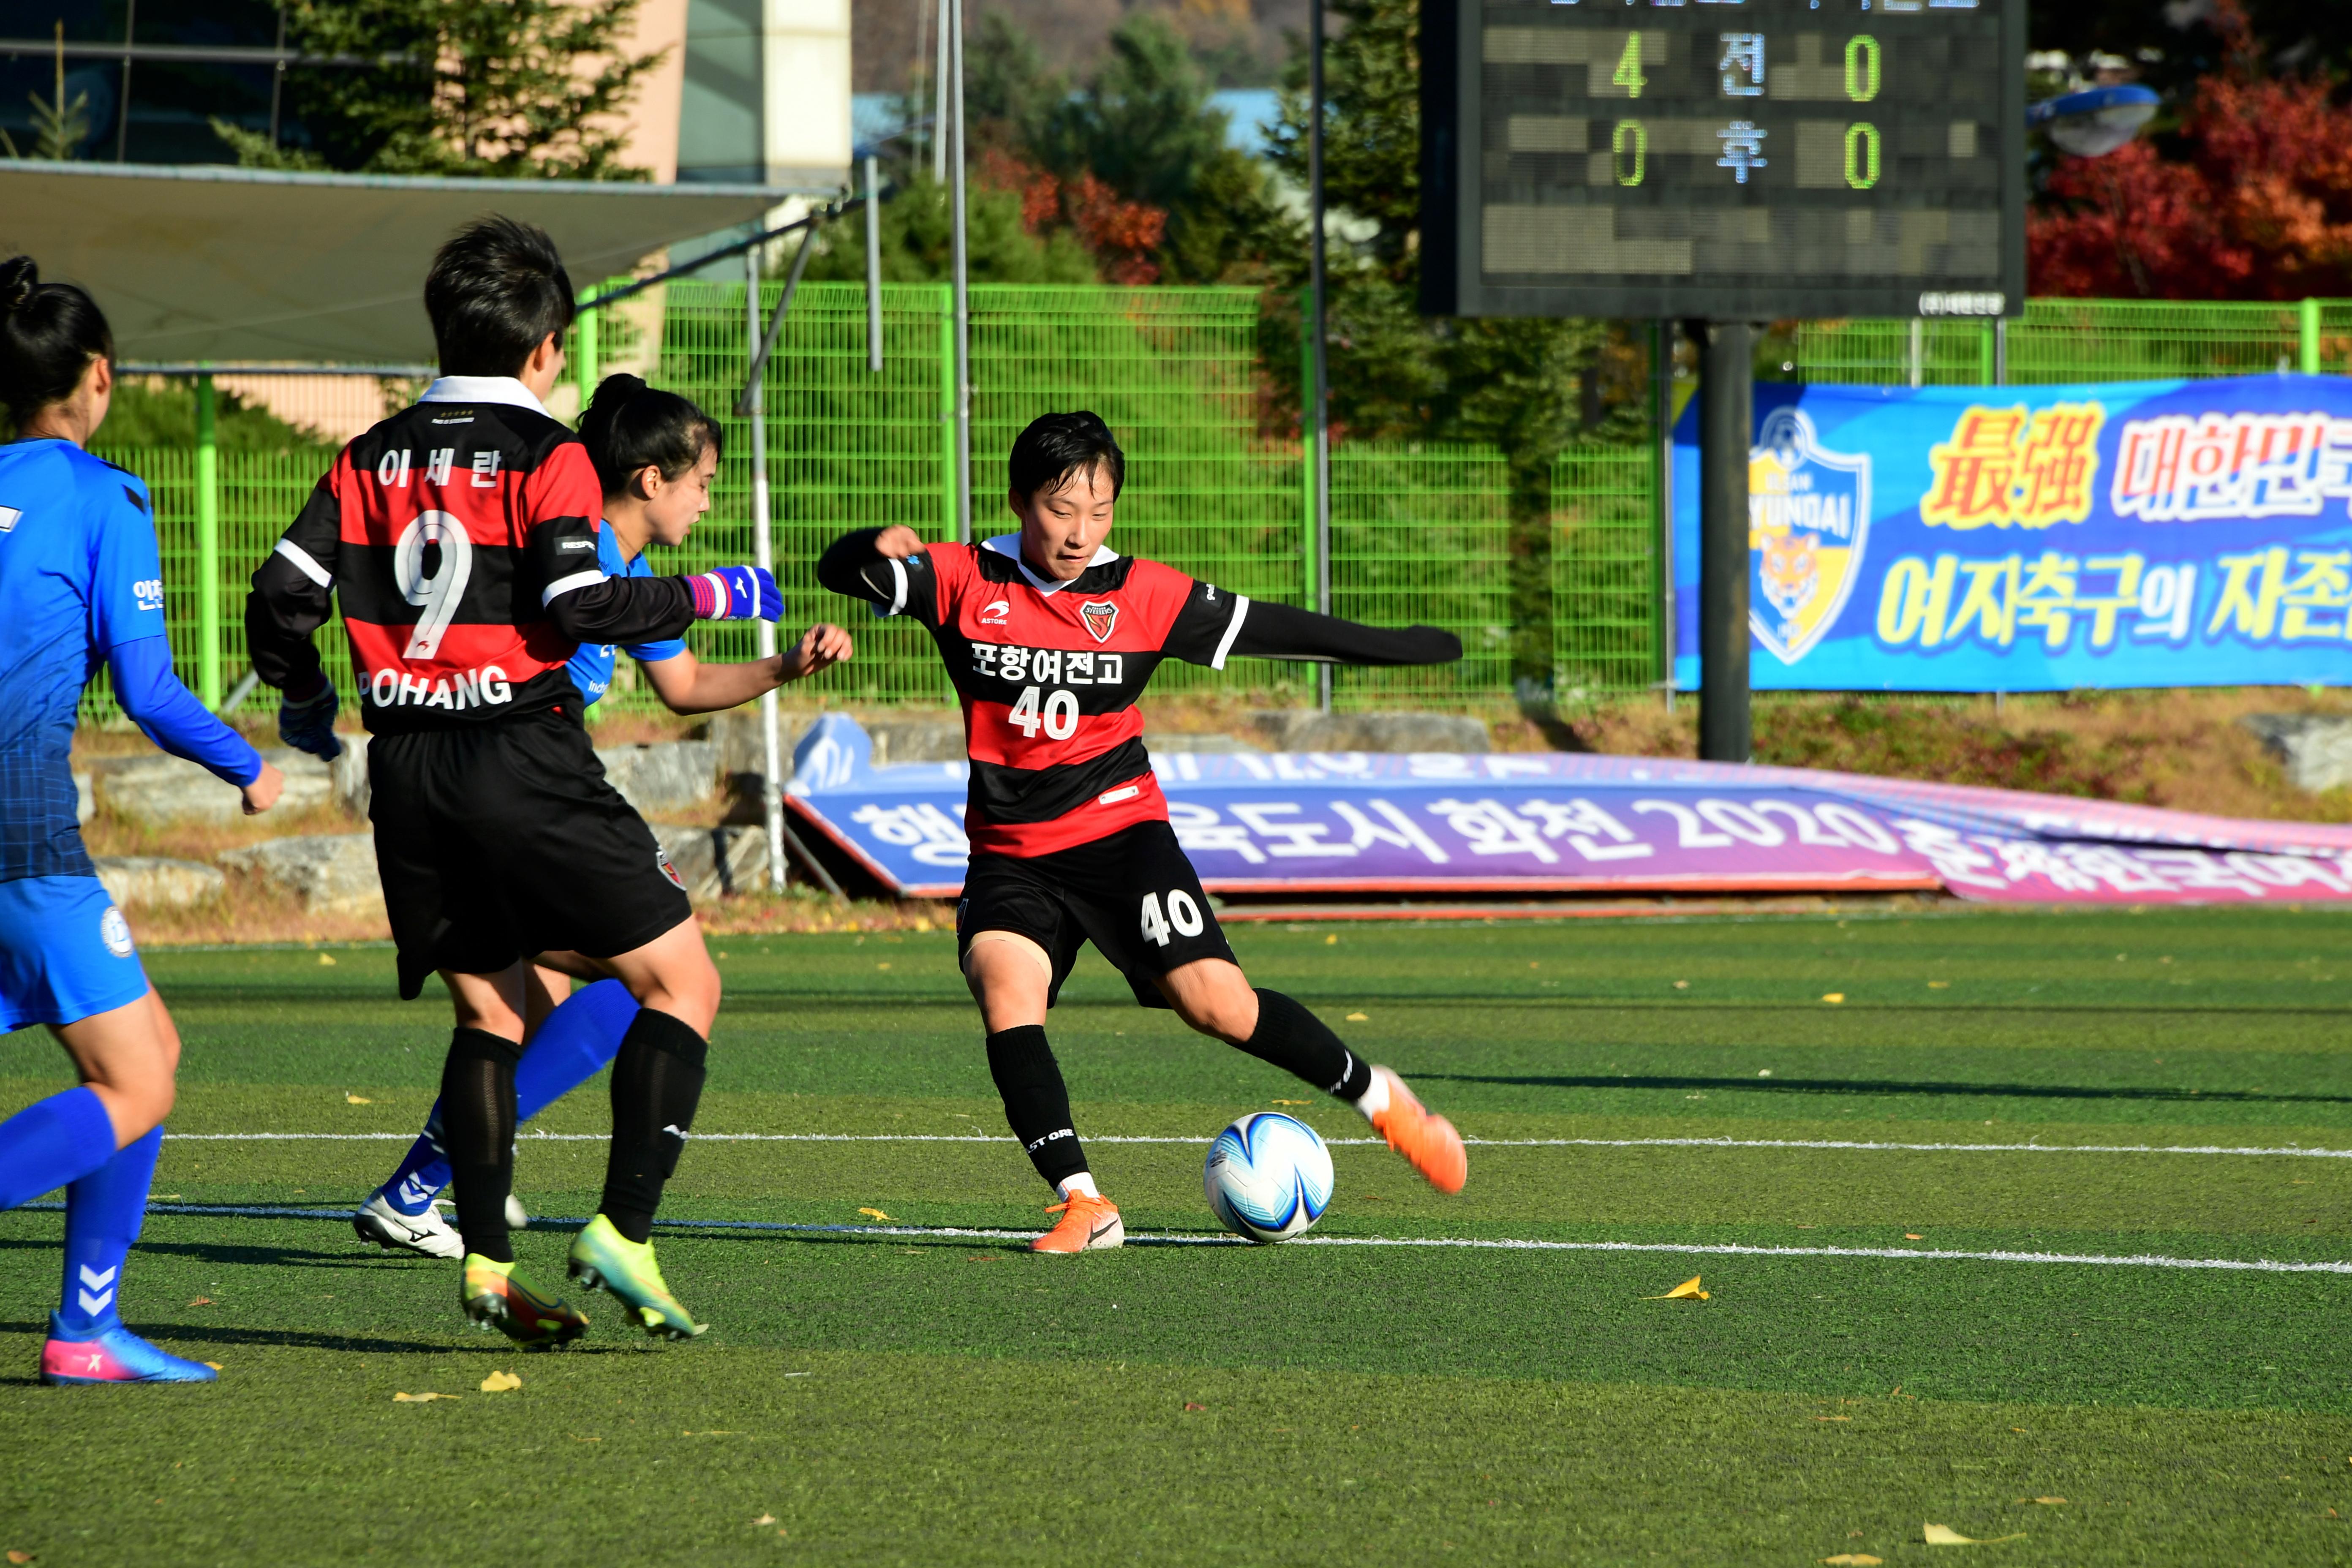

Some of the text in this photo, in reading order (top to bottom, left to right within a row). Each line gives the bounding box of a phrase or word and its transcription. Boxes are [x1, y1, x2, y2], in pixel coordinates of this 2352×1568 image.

[1613, 31, 1881, 102] 4 전 0
[1612, 119, 1881, 190] 0 후 0
[1749, 493, 1852, 540] YUNDAI
[394, 509, 473, 660] 9
[1877, 547, 2352, 647] 여자축구의 자존
[971, 642, 1123, 685] 포항여전고
[1008, 686, 1080, 740] 40
[1631, 798, 1900, 855] 2020
[1141, 888, 1204, 948] 40
